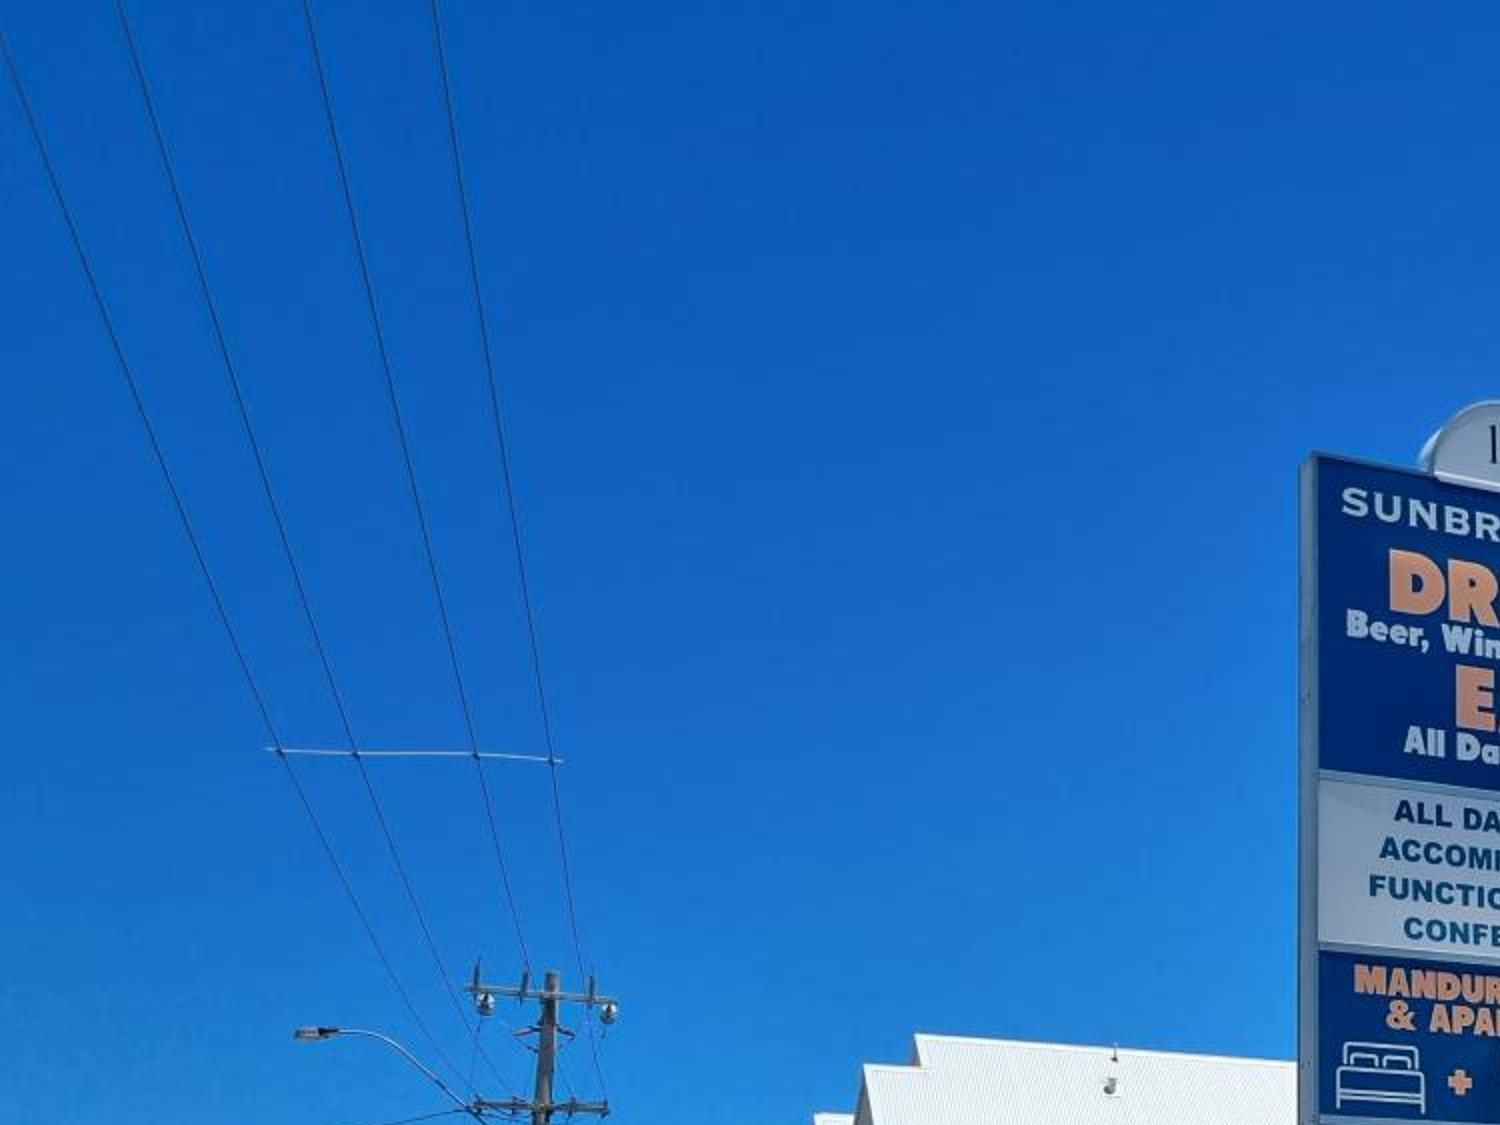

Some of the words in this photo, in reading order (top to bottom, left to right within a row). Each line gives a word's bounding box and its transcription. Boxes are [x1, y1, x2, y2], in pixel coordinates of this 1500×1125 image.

[1346, 609, 1430, 654] Beer,
[1404, 725, 1446, 758] All
[1393, 799, 1454, 829] ALL
[1386, 999, 1416, 1031] &
